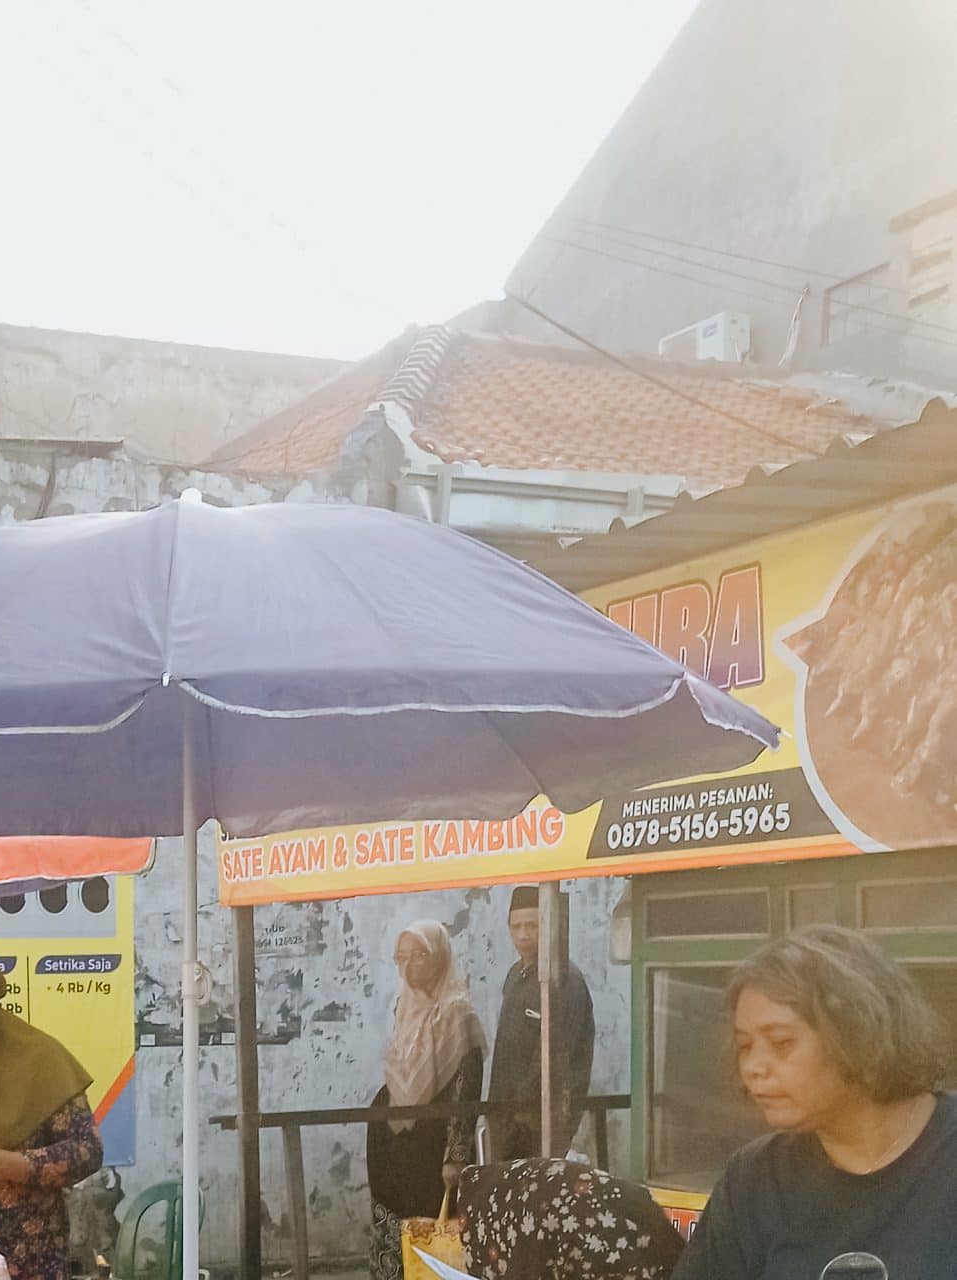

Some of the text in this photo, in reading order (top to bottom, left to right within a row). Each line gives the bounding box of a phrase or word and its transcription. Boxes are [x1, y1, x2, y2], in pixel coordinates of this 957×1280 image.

[623, 783, 773, 818] MENERIMA PESANAN:
[607, 803, 791, 849] 0878-5156-5965
[222, 807, 564, 881] SATE AYAM & SATE KAMBING
[45, 957, 112, 973] Setrika Saja
[56, 982, 64, 993] 4
[68, 982, 84, 992] Rb
[95, 982, 111, 994] Kg
